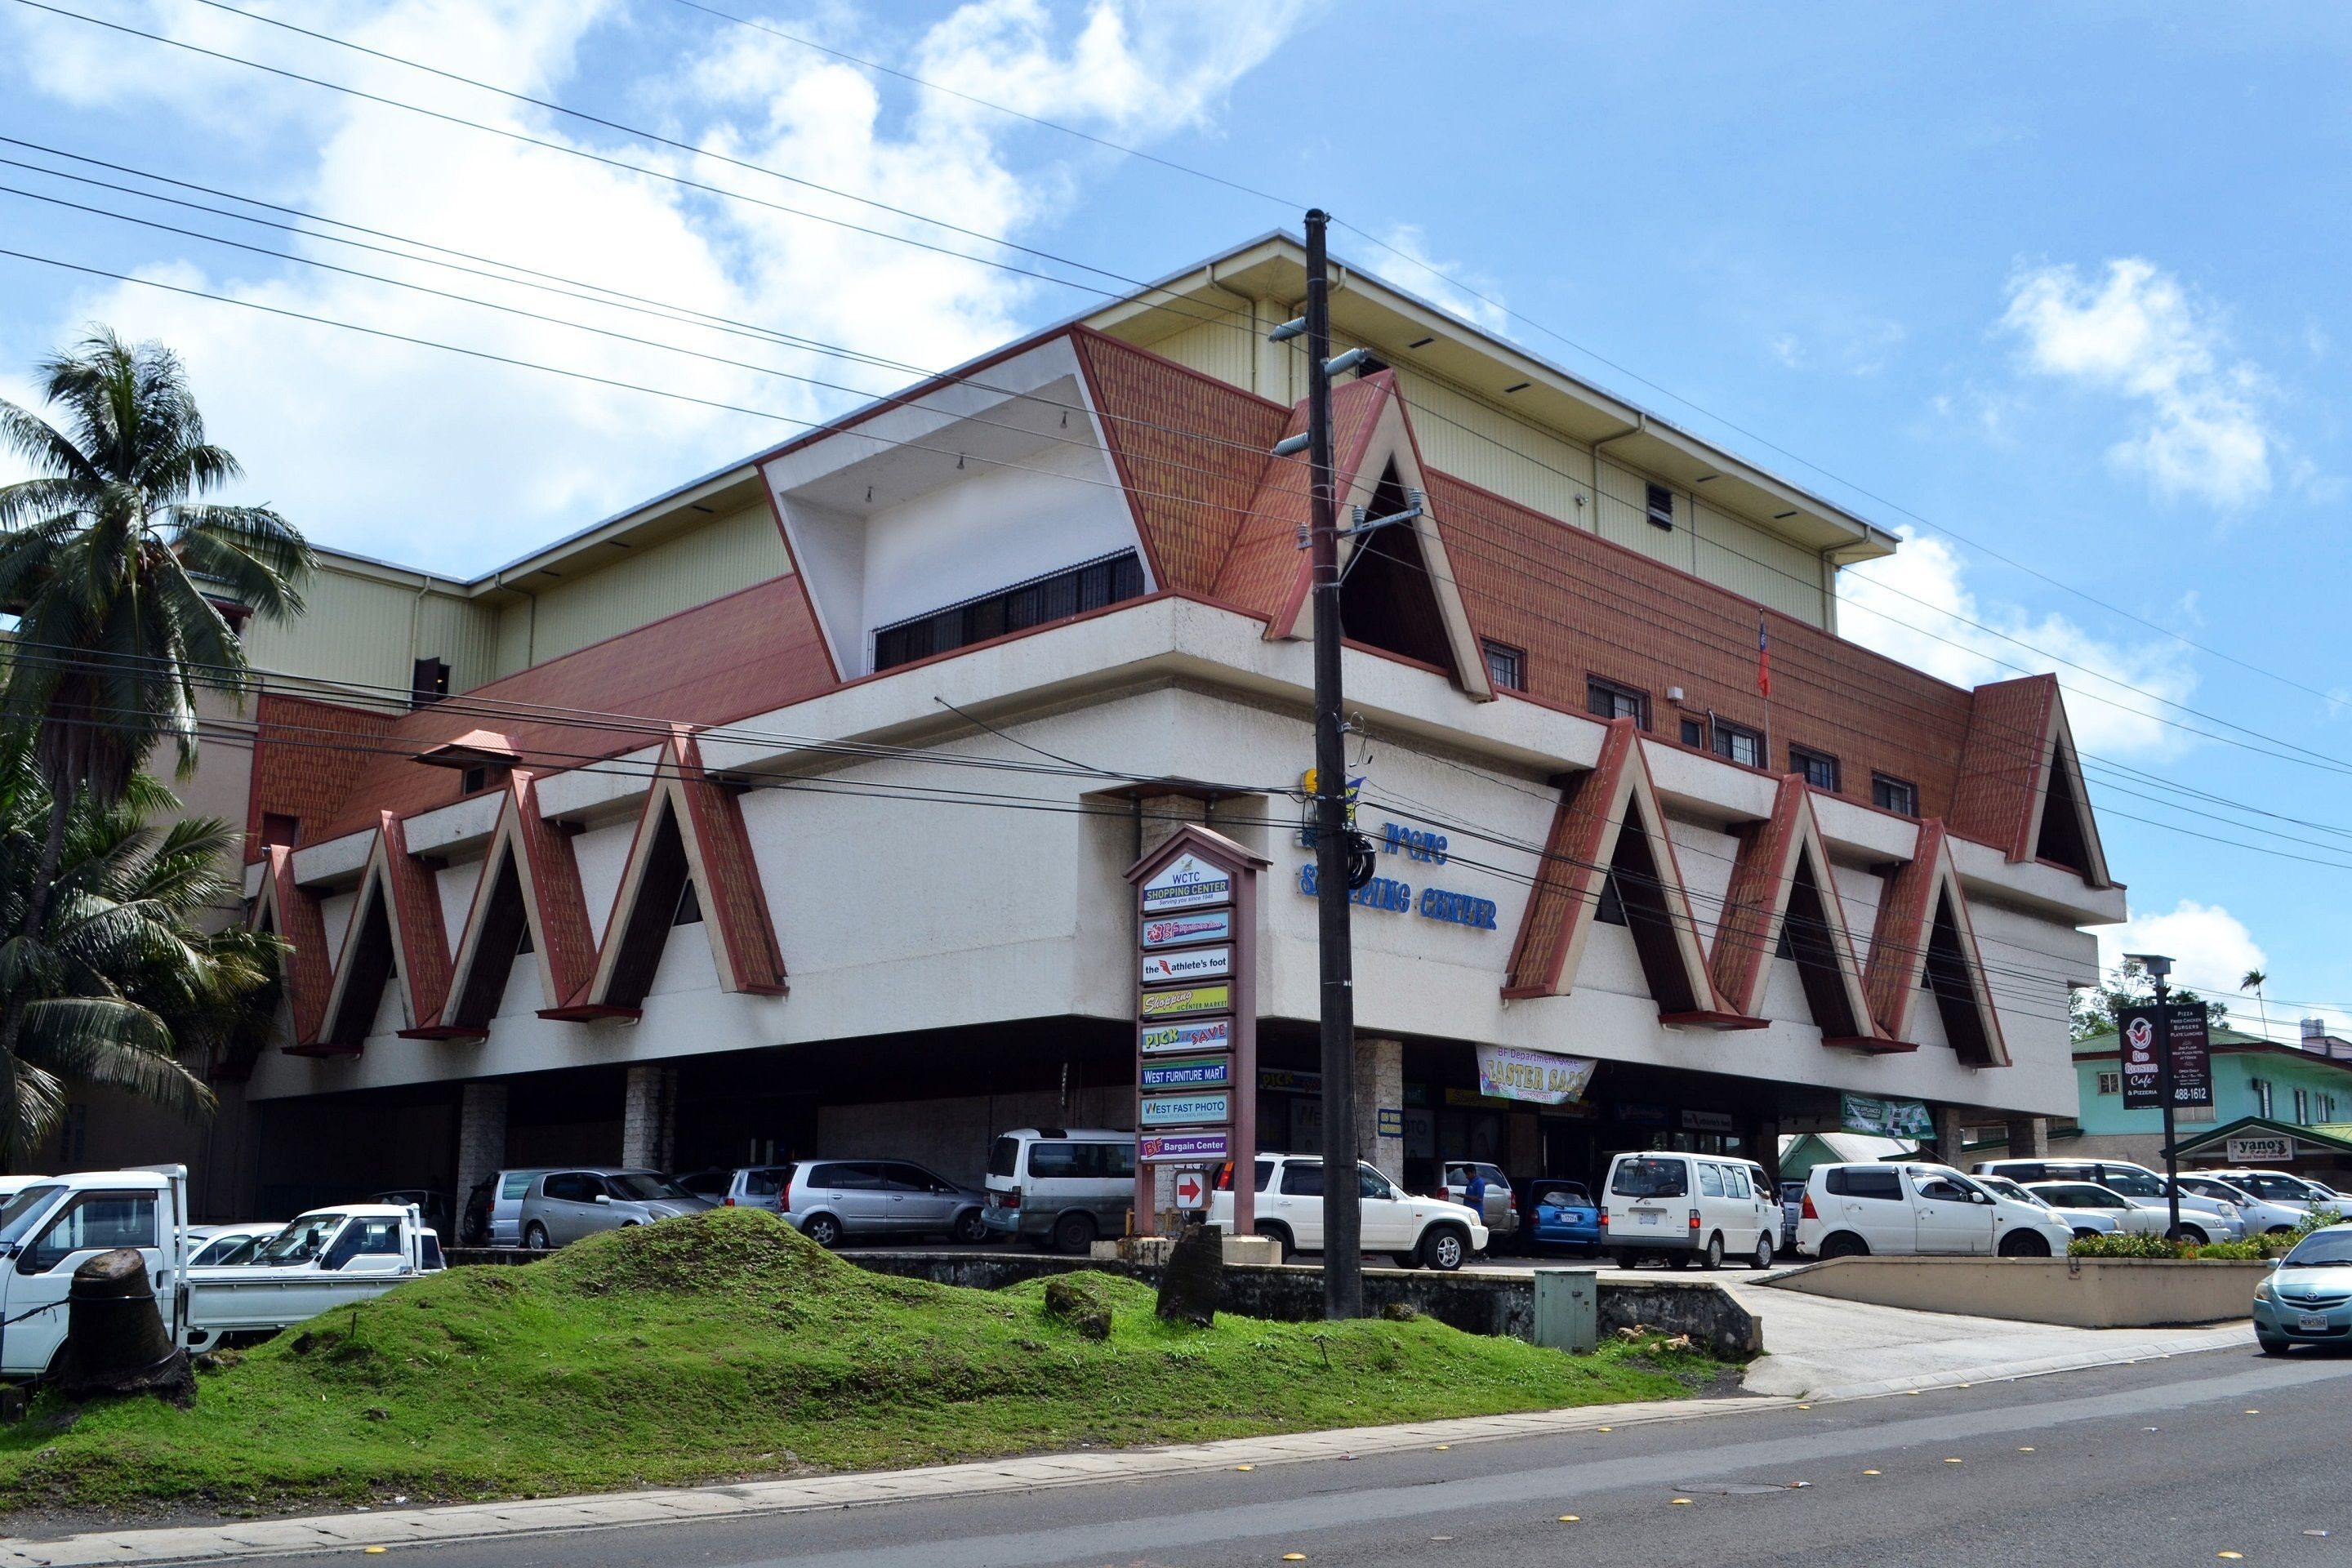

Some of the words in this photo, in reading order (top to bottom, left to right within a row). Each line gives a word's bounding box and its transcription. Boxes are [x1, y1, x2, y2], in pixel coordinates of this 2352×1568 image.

[1172, 871, 1200, 884] WCTC
[1147, 886, 1190, 900] SHOPPING
[1192, 881, 1226, 894] CENTER
[1420, 888, 1497, 930] CENTER
[1145, 964, 1159, 974] the
[1171, 959, 1207, 972] athlete's
[1209, 957, 1226, 967] foot
[1144, 991, 1192, 1013] Shopping
[1181, 1003, 1202, 1011] CENTER
[1146, 1028, 1179, 1049] PICK
[1191, 1024, 1226, 1045] SAVE
[1498, 1047, 1508, 1057] BF
[1510, 1049, 1557, 1065] Department
[1558, 1058, 1579, 1067] Store
[2132, 1050, 2149, 1062] RED
[1144, 1071, 1164, 1084] WEST
[1165, 1069, 1203, 1082] FURNITURE
[1205, 1066, 1225, 1080] MART
[1486, 1060, 1544, 1090] EASTER
[2125, 1062, 2158, 1074] ROOSTER
[2174, 1087, 2207, 1100] 488-1612
[1144, 1102, 1171, 1114] WEST
[1173, 1103, 1192, 1113] FAST
[1195, 1101, 1225, 1111] PHOTO
[1144, 1137, 1163, 1158] BF
[1165, 1142, 1195, 1152] Bargain
[1196, 1141, 1224, 1150] Center
[2239, 1140, 2284, 1153] yano's
